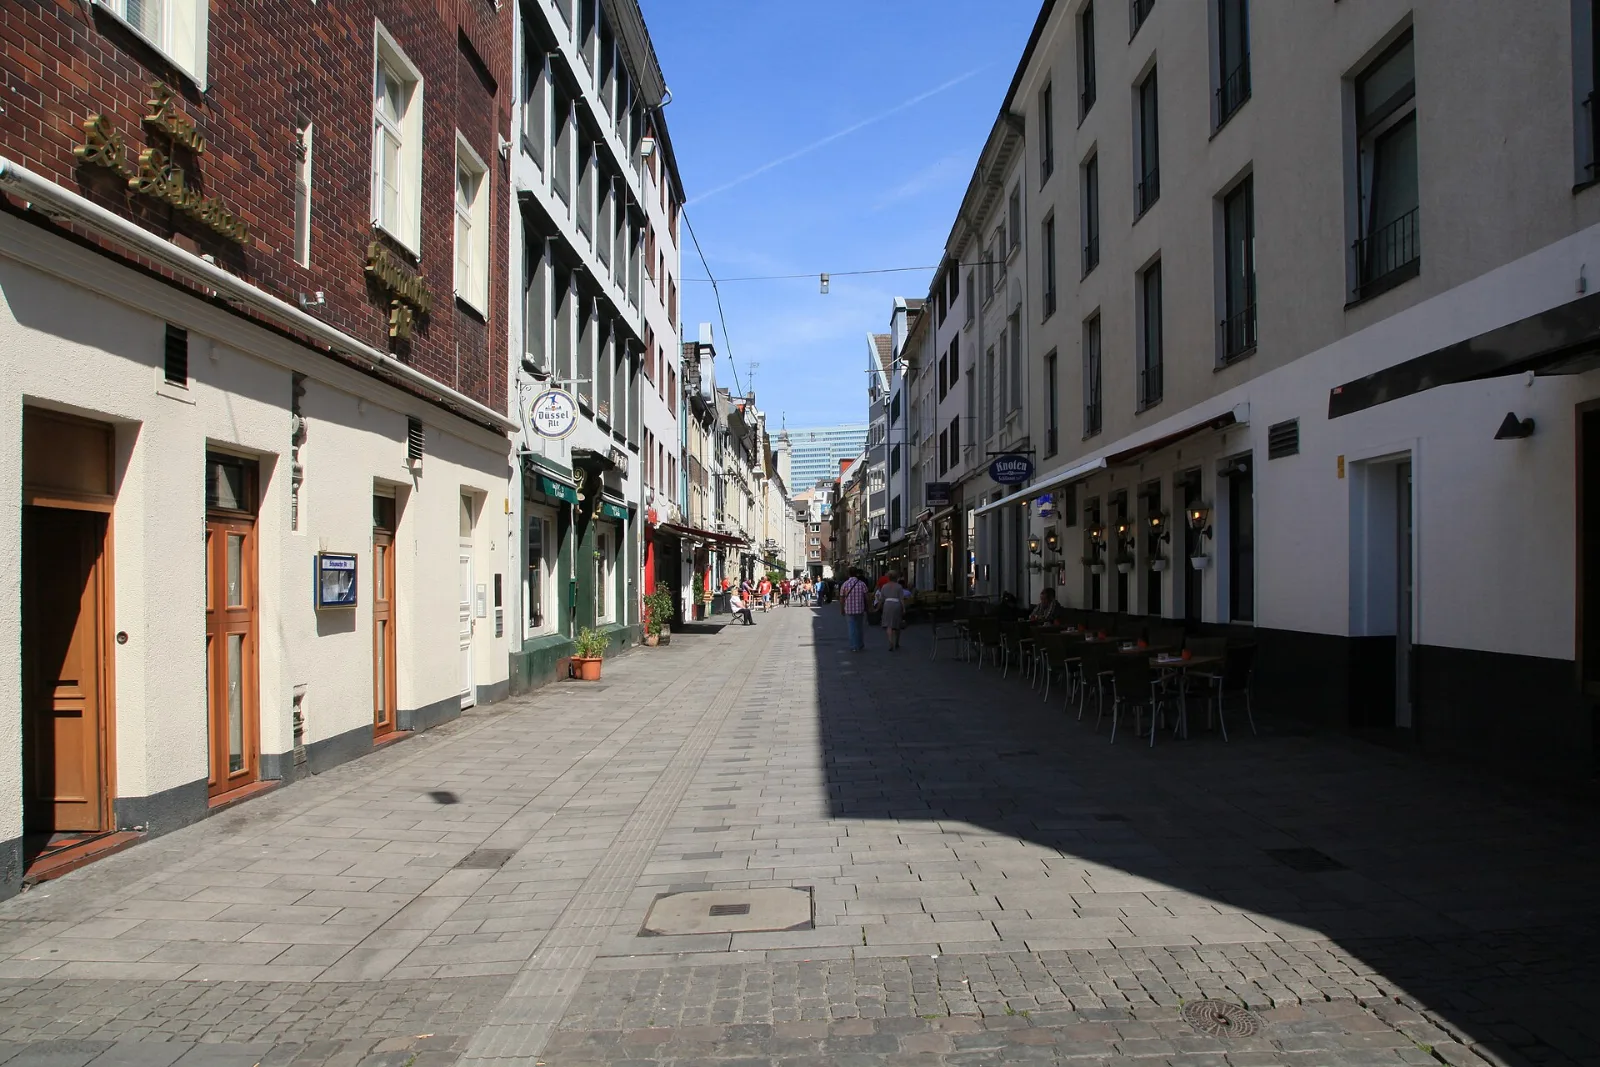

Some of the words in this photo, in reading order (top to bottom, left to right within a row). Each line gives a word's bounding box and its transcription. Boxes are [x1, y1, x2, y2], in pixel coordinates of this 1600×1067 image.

[538, 411, 569, 420] Düssel
[548, 419, 559, 428] Alt
[996, 460, 1028, 472] Knoten
